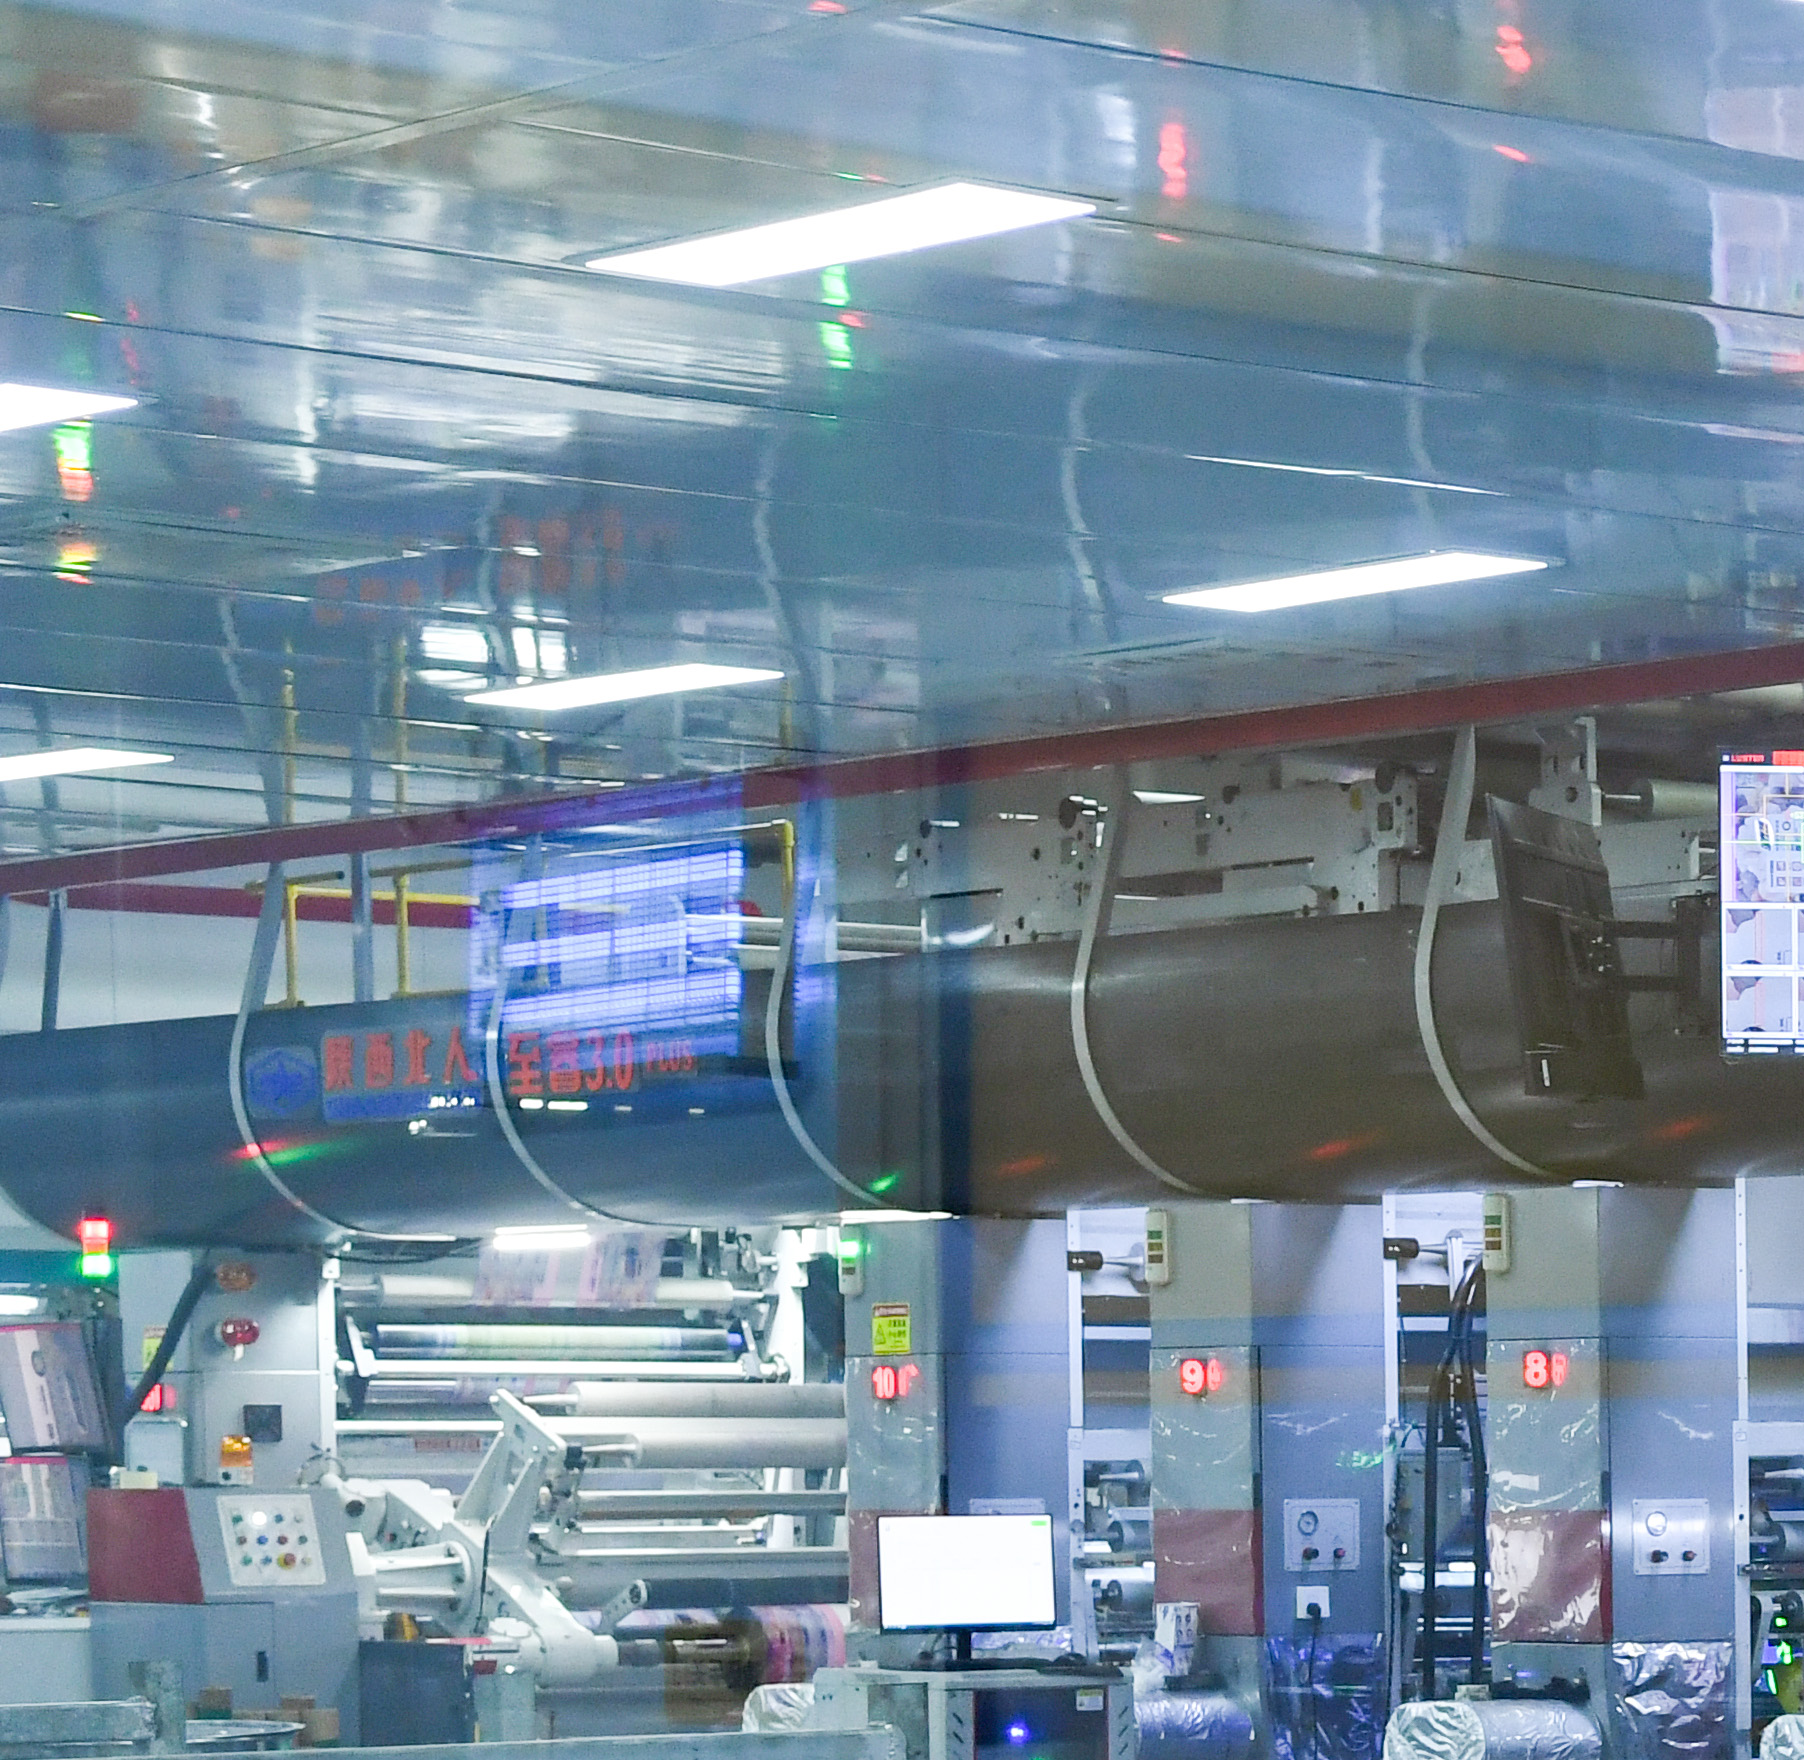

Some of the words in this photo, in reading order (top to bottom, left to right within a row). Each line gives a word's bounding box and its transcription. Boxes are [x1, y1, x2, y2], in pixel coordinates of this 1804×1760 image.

[646, 1040, 694, 1072] PLUS
[872, 1366, 897, 1399] 10
[1180, 1359, 1206, 1394] 9
[1523, 1350, 1550, 1388] 8
